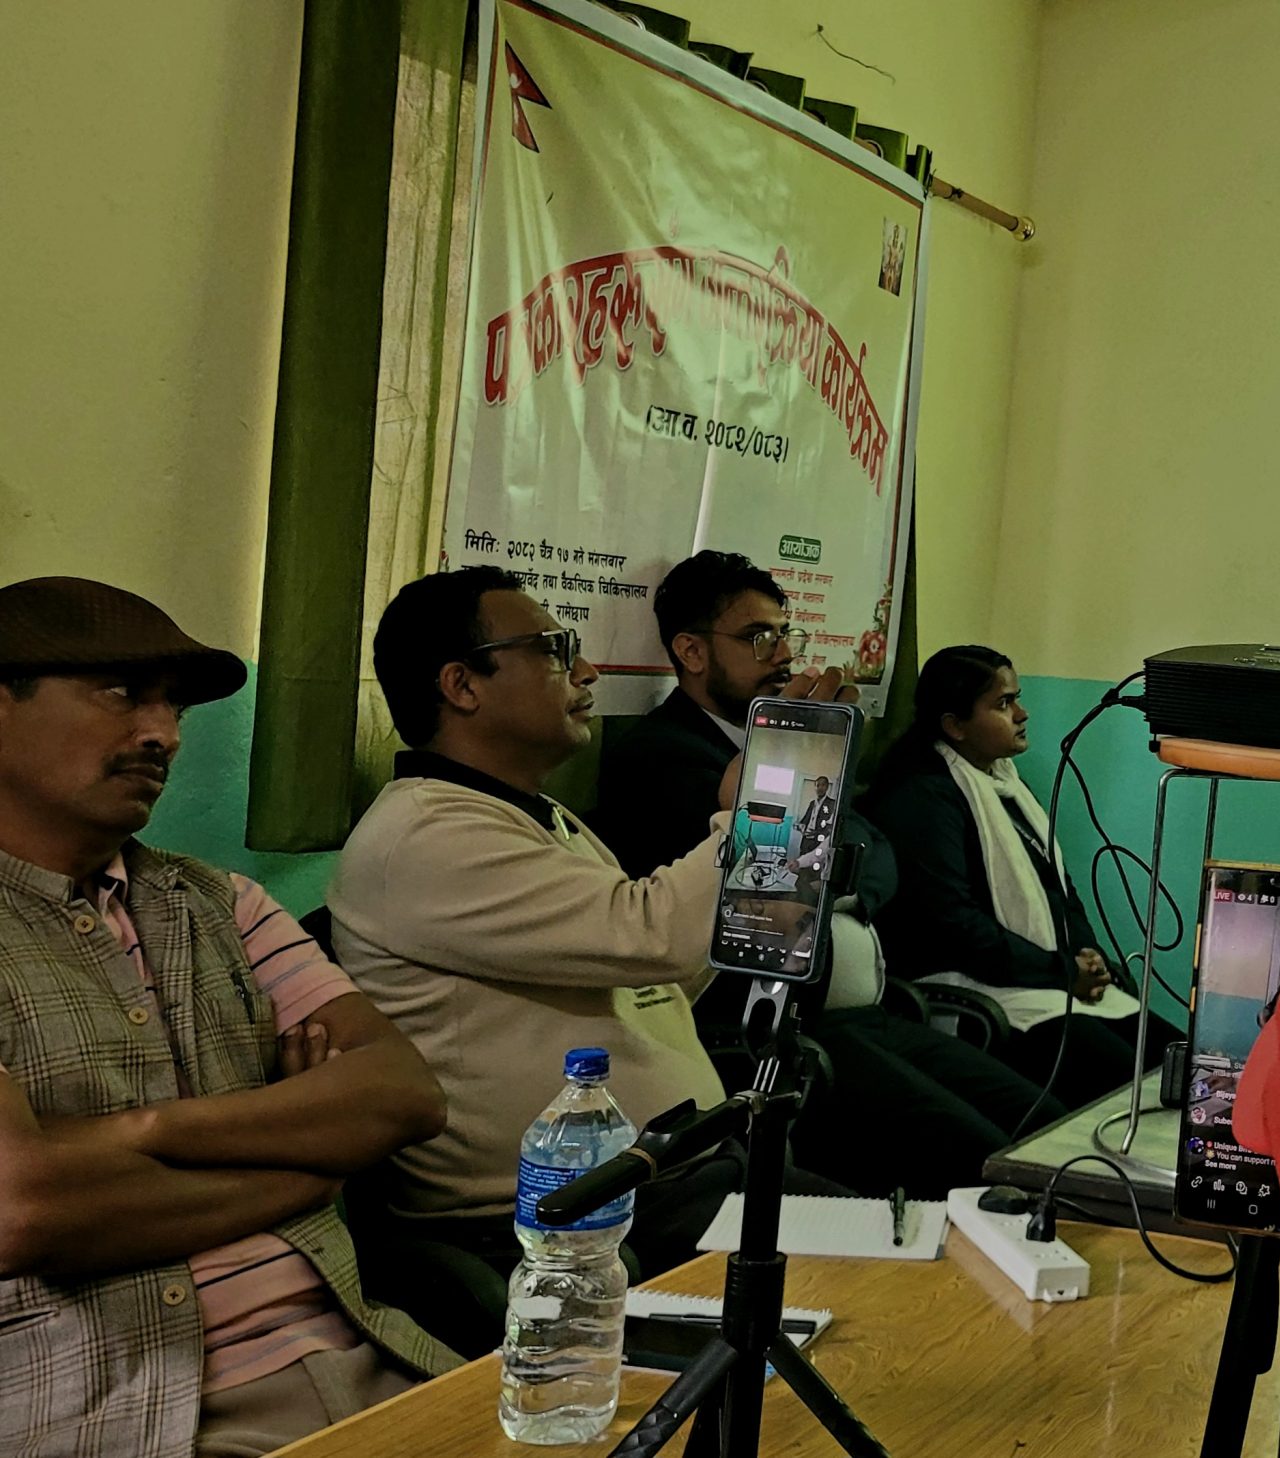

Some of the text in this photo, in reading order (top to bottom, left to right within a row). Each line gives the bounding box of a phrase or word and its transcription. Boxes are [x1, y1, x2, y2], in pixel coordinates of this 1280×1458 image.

[821, 322, 890, 497] कार्यक्रम
[507, 540, 536, 561] २०८२
[540, 538, 554, 560] चैत्र
[557, 546, 570, 562] १७
[573, 546, 585, 566] गते
[780, 539, 820, 558] आयोजक
[543, 573, 559, 590] तथा
[561, 570, 596, 594] वैकल्पिक
[599, 575, 649, 599] चिकित्सालय
[556, 602, 590, 622] रामेछाप
[1214, 1142, 1238, 1152] Unique
[1205, 1159, 1237, 1171] See more
[1217, 1152, 1229, 1160] You
[1230, 1154, 1243, 1162] can
[1244, 1156, 1270, 1166] support
